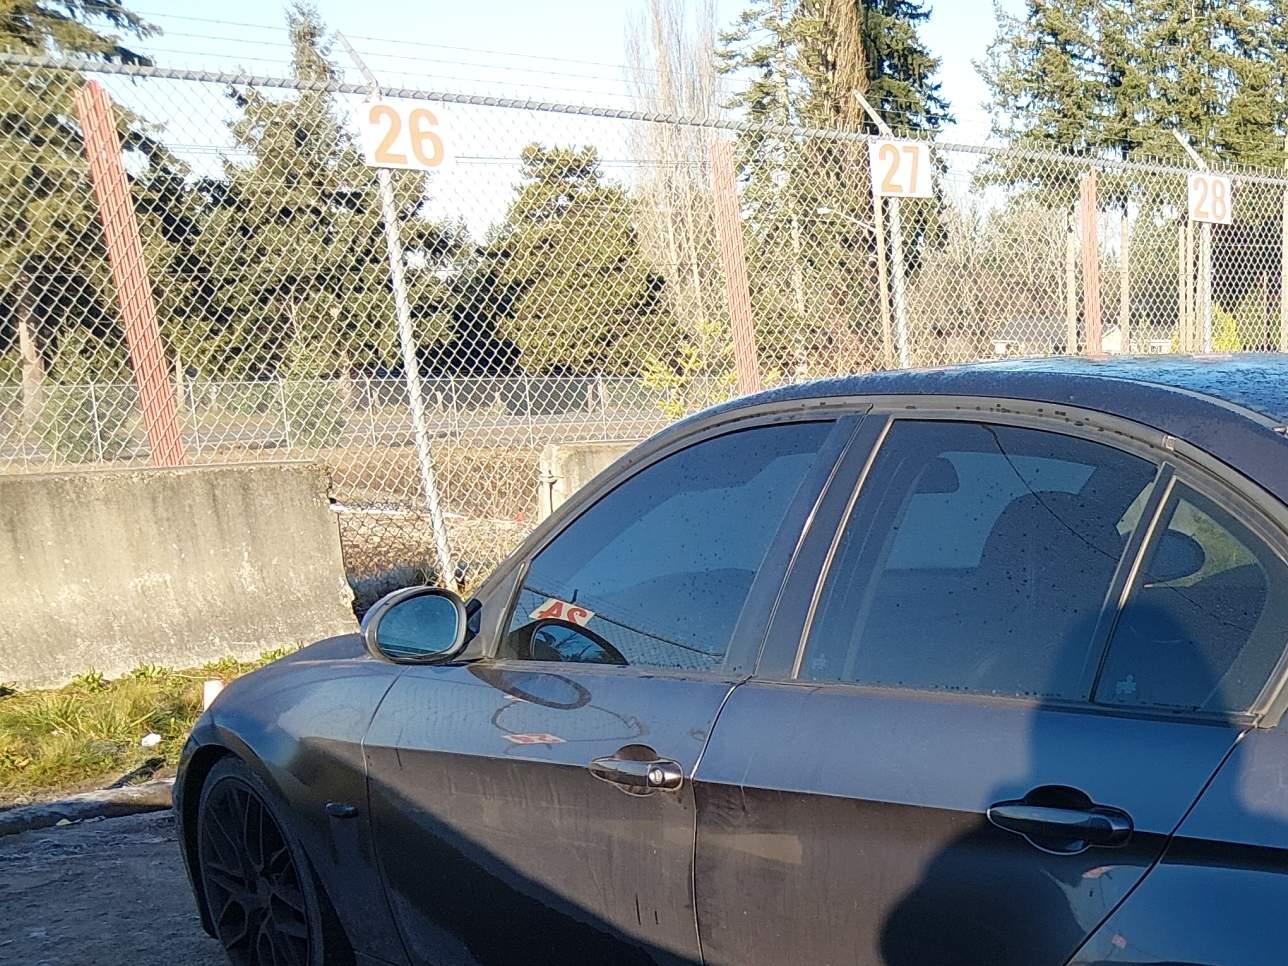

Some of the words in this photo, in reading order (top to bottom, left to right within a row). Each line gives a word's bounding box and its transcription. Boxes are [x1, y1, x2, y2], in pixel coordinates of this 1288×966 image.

[369, 104, 444, 167] 26
[877, 144, 922, 195] 27
[1192, 176, 1228, 221] 28
